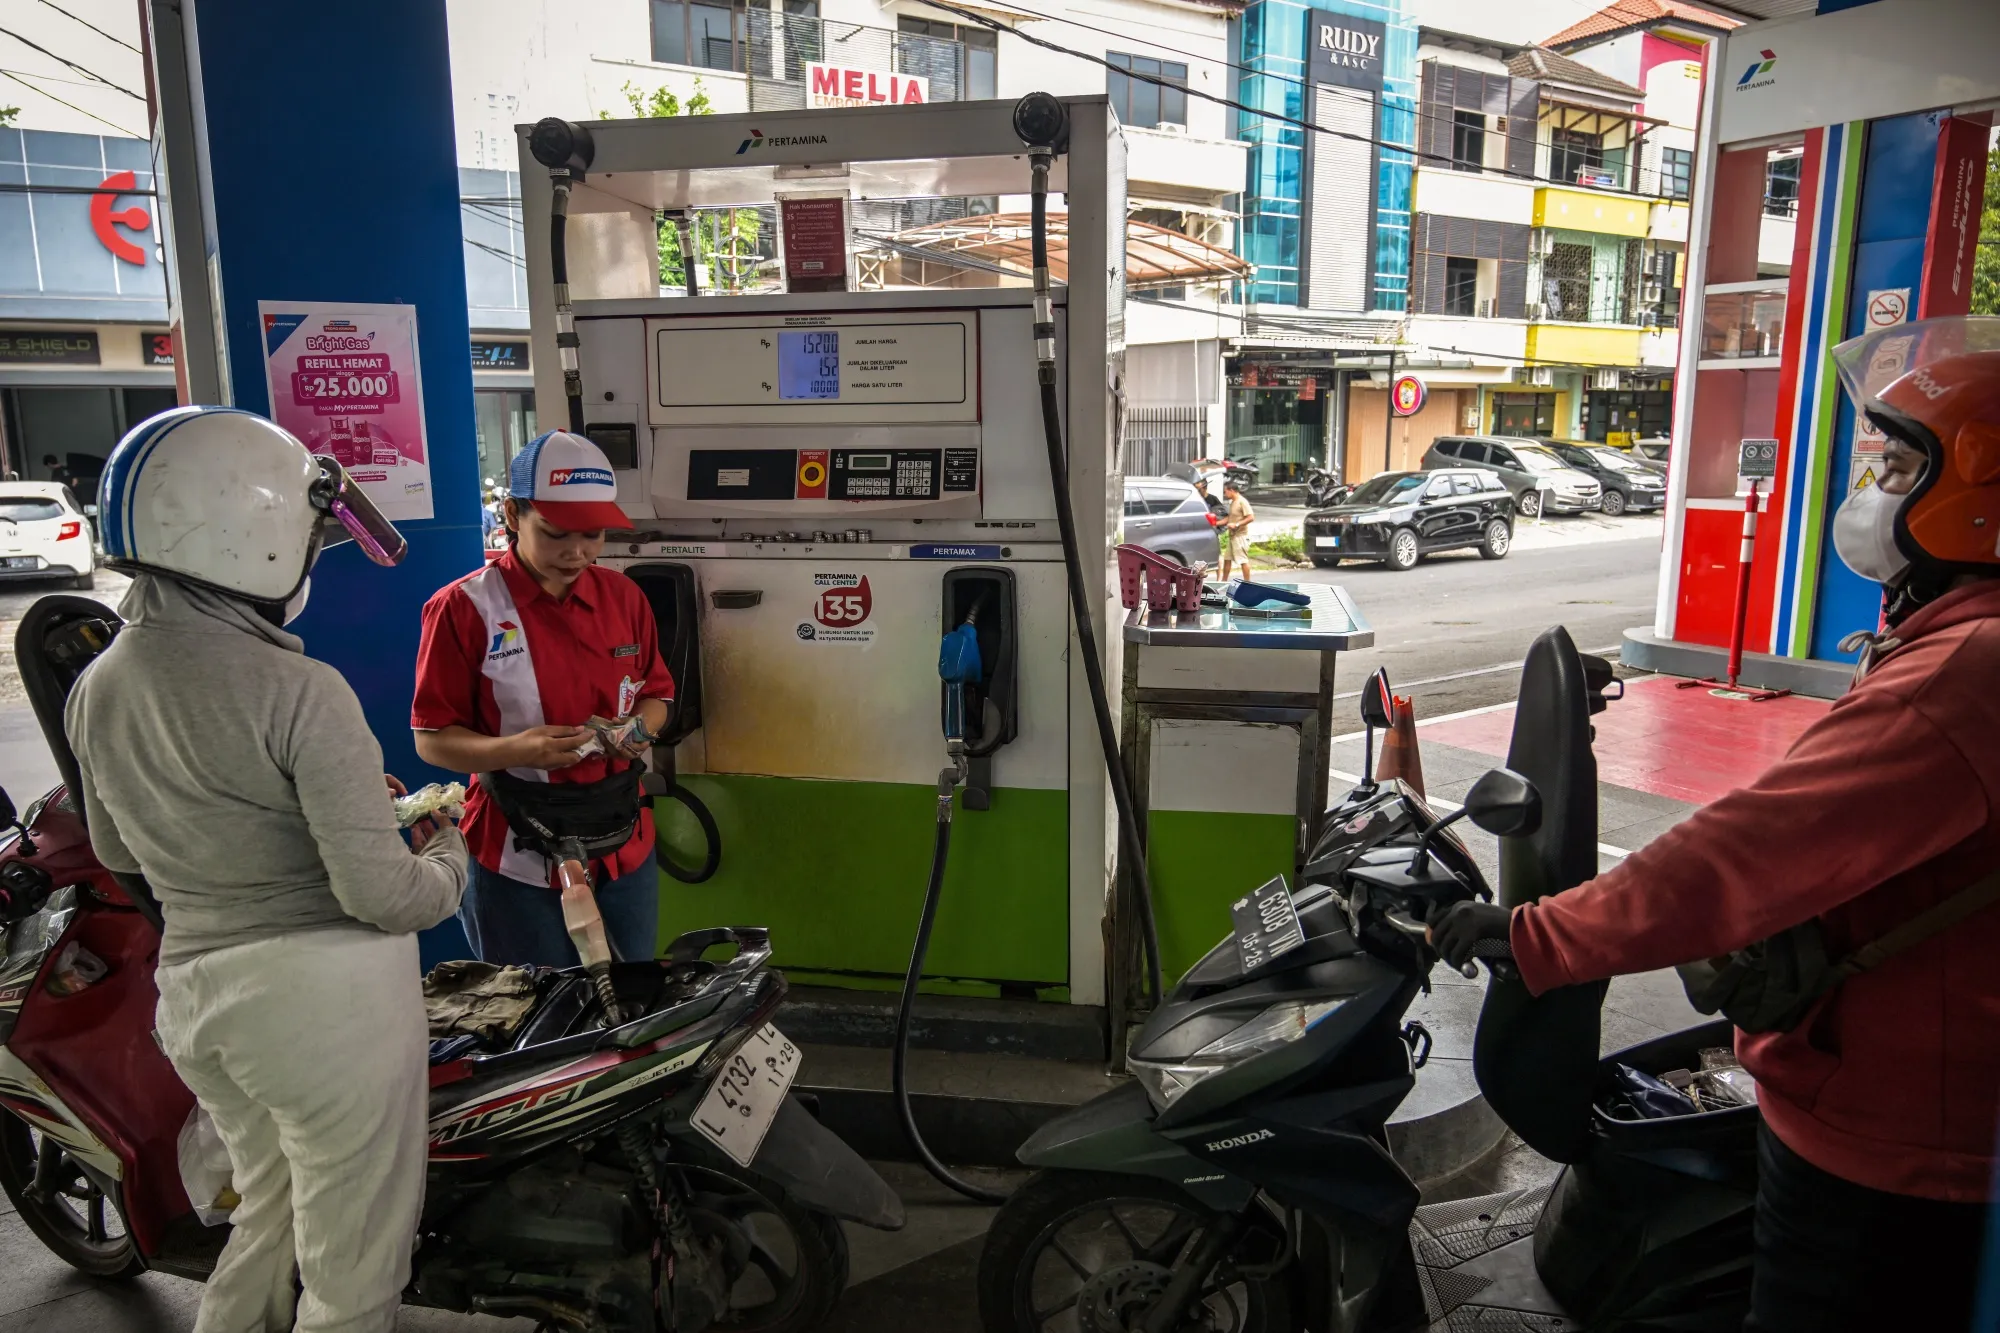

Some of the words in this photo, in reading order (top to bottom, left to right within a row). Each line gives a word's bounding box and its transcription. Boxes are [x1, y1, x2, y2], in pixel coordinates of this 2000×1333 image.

[1320, 25, 1380, 57] RUDY
[1330, 53, 1338, 65] &
[812, 66, 923, 104] MELIA
[1736, 79, 1776, 92] PERTAMINA
[768, 135, 828, 147] PERTAMINA
[1952, 158, 1965, 228] PERTAMINA
[1952, 159, 1974, 296] Enduro
[16, 338, 91, 351] SHIELD
[307, 337, 345, 351] Bright
[346, 338, 370, 349] Gas
[804, 334, 838, 354] 15200
[305, 358, 340, 369] REFILL
[343, 358, 383, 369] HEMAT
[314, 377, 387, 397] 25.000
[661, 546, 705, 554] PERTALITE
[817, 595, 864, 621] 135
[488, 647, 525, 661] PERTAMINA
[1254, 877, 1278, 897] L
[1258, 891, 1294, 933] 6308
[700, 1118, 726, 1137] L
[717, 1055, 757, 1109] 4732
[1205, 1128, 1276, 1152] HONDA
